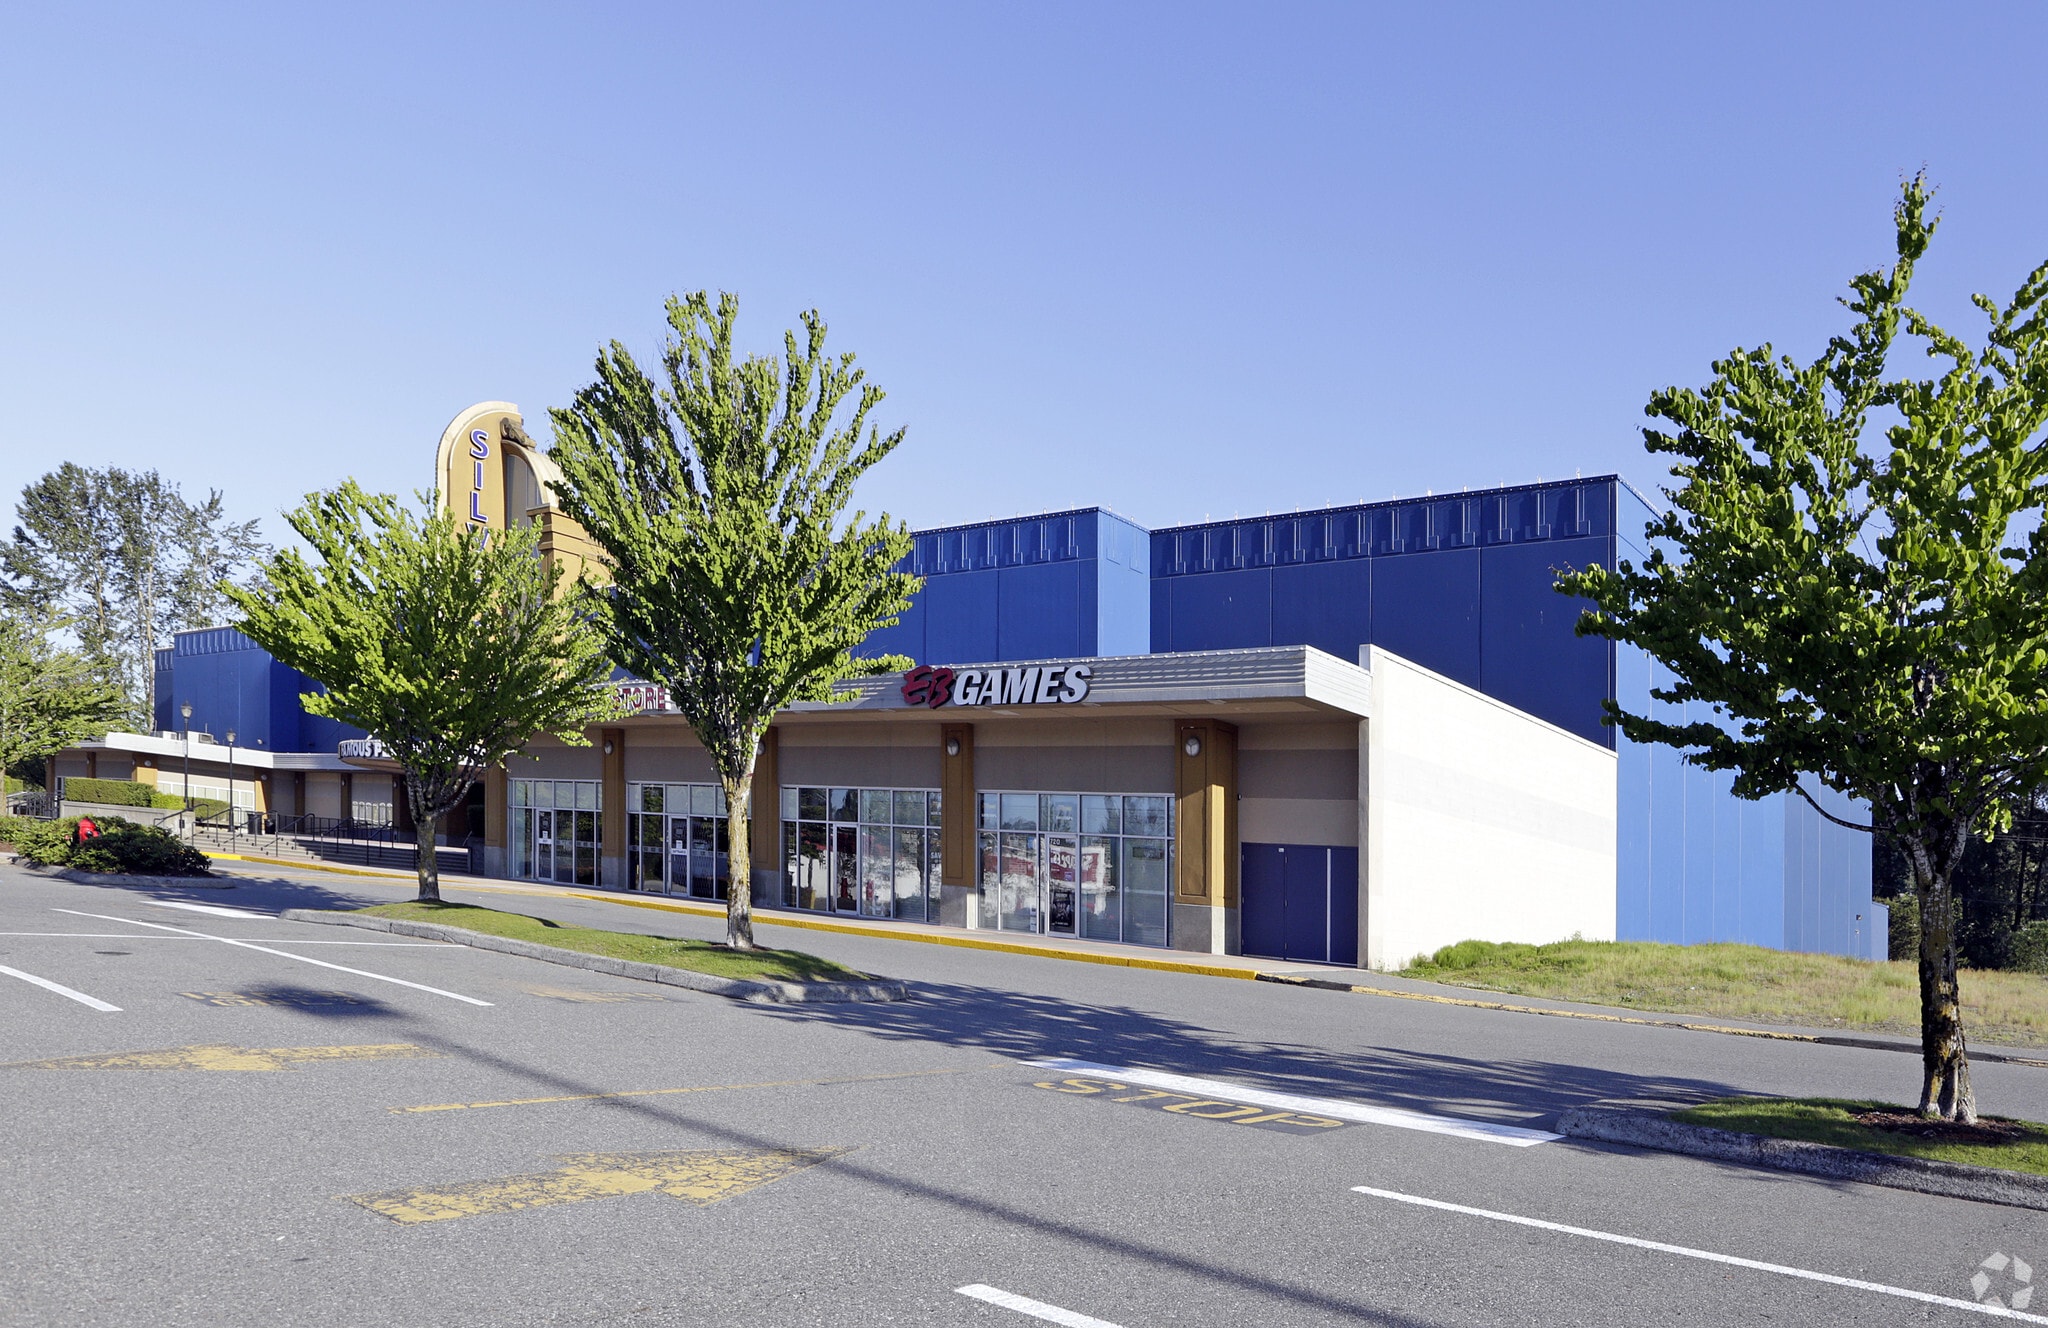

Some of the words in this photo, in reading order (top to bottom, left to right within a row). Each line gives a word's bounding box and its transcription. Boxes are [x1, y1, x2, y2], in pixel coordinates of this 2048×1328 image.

[901, 665, 954, 709] EB
[953, 664, 1092, 706] GAMES
[1032, 1079, 1346, 1129] STOP
